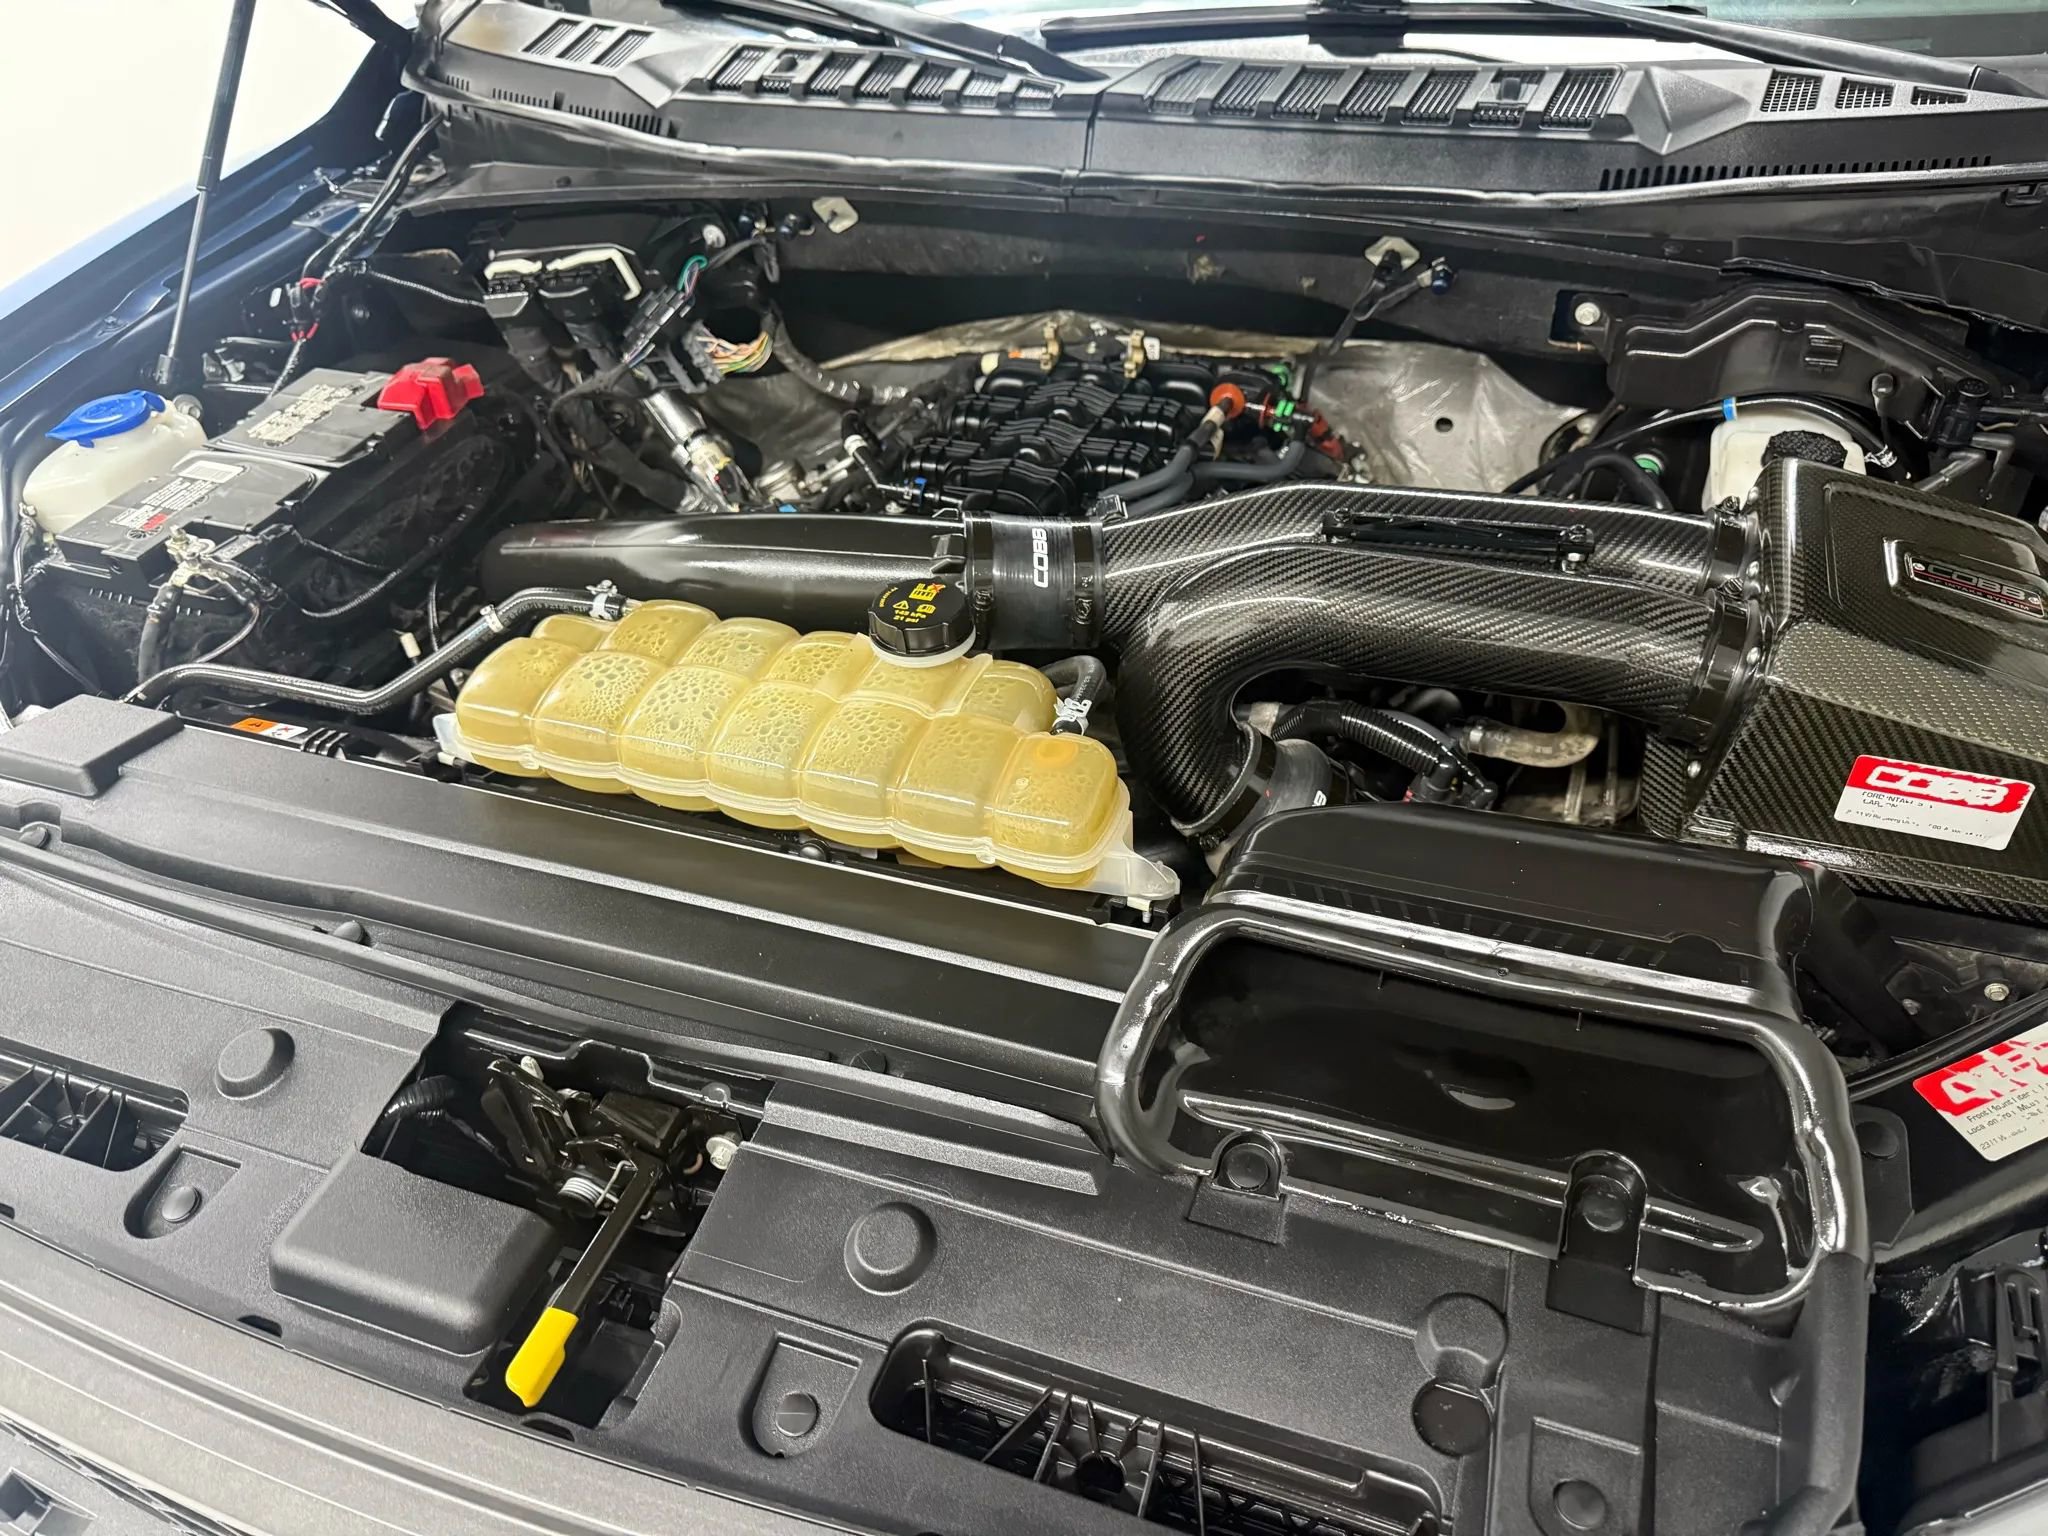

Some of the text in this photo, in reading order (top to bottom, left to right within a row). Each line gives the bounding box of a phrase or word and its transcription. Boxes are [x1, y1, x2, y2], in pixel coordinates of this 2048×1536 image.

[1031, 527, 1049, 588] COBB
[1927, 563, 2026, 600] COBB
[1865, 765, 2010, 808] COBB
